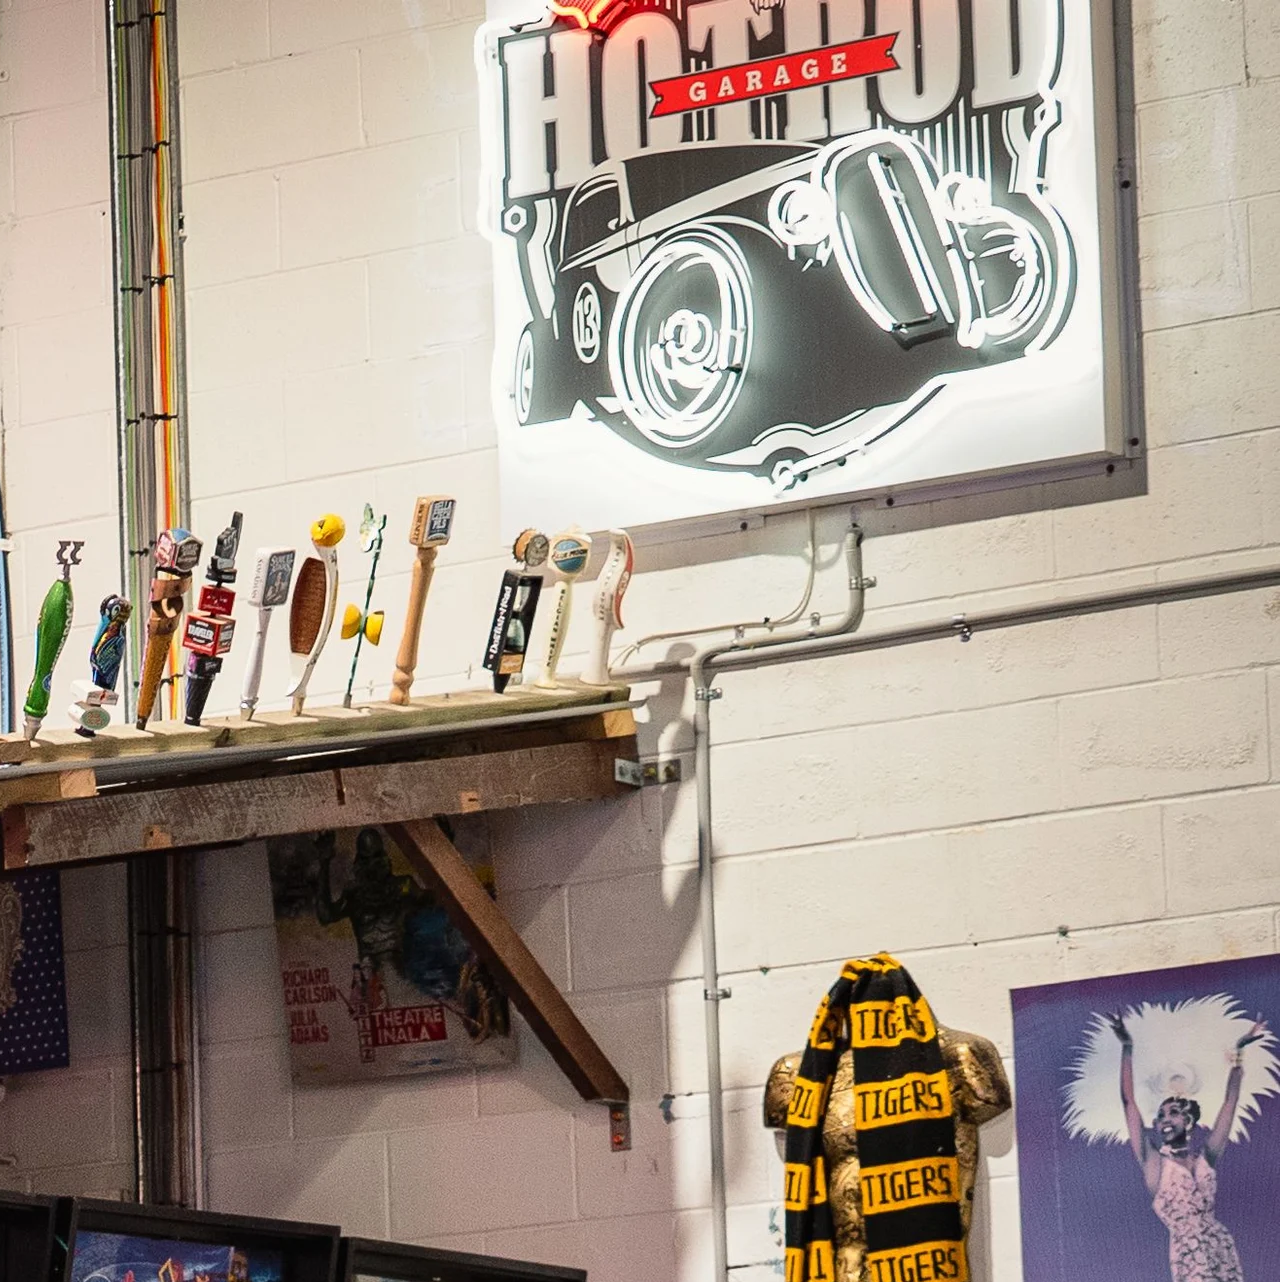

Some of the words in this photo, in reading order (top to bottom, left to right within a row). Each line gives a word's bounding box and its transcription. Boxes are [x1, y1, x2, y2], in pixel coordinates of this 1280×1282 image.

[688, 52, 848, 103] GARAGE
[282, 967, 330, 988] RICHARD
[284, 985, 337, 1005] CARLSON
[371, 1006, 443, 1028] THEATRE
[377, 1027, 432, 1043] INALA
[857, 1079, 943, 1123] TIGERS
[862, 1164, 953, 1207] TIGERS
